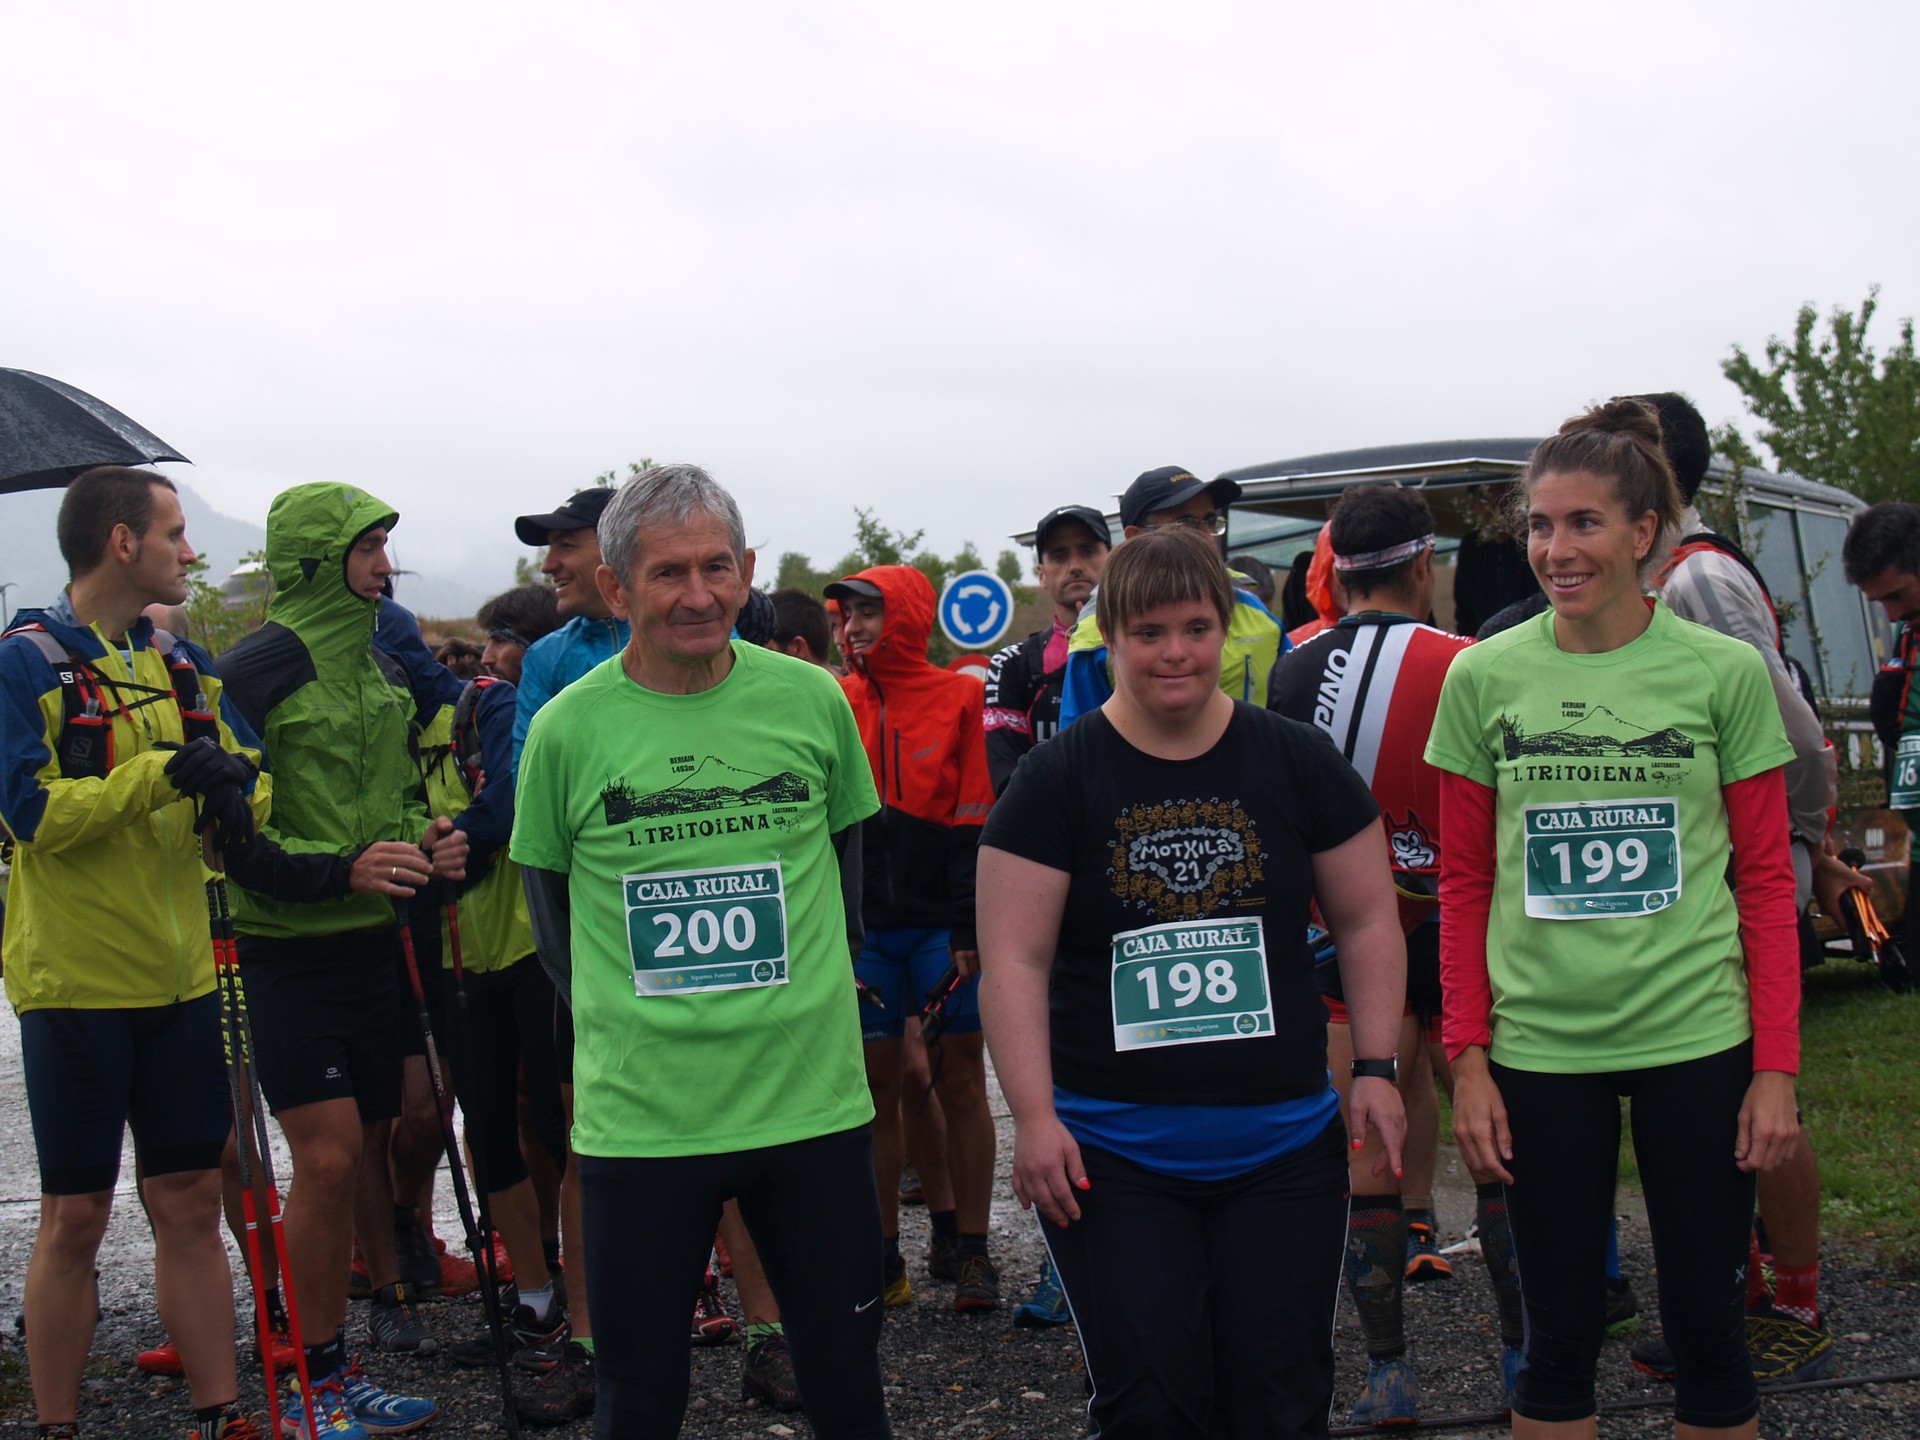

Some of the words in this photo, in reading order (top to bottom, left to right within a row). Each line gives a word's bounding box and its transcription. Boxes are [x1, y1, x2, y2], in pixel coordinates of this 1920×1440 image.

[985, 642, 1024, 704] LIZAR
[1562, 701, 1586, 709] BERIAIN
[669, 754, 695, 764] BERIAIN
[1535, 811, 1585, 830] CAJA
[1590, 807, 1666, 827] RURAL
[1173, 860, 1200, 881] 21
[1550, 838, 1649, 884] 199
[636, 880, 690, 901] CAJA
[693, 873, 771, 896] RURAL
[652, 906, 756, 958] 200
[1122, 934, 1171, 958] CAJA
[1175, 927, 1251, 949] RURAL
[219, 964, 231, 1011] LEKI
[231, 963, 247, 1010] LEKI
[1136, 959, 1238, 1010] 198
